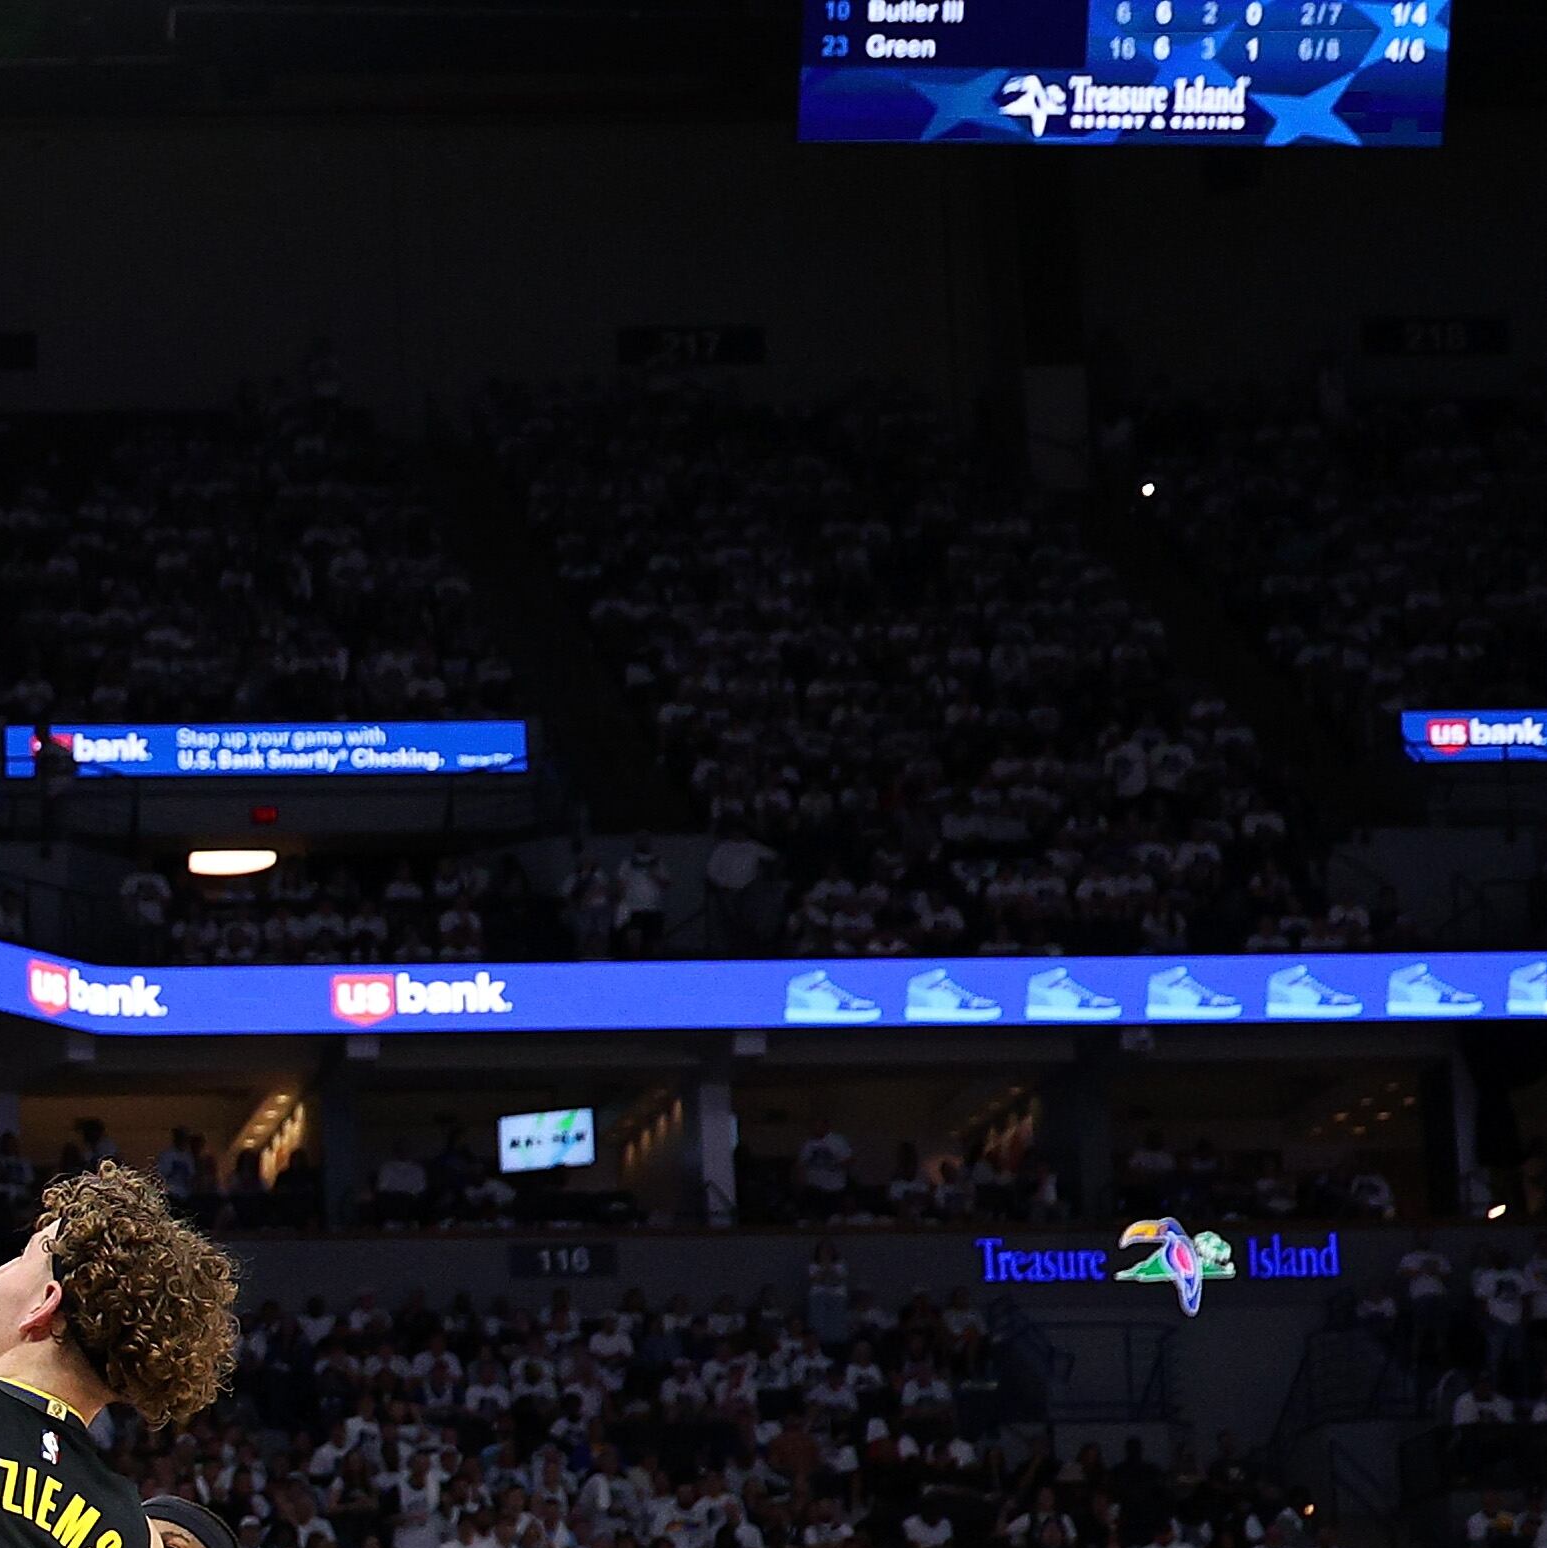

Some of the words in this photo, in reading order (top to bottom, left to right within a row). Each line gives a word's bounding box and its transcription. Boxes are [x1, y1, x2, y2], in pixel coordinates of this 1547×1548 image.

[865, 34, 937, 58] Green
[1068, 74, 1169, 114] Treasure
[1173, 74, 1248, 114] Island
[1430, 722, 1468, 744] us
[30, 968, 68, 1004] us
[335, 981, 391, 1015] us
[976, 1237, 1105, 1283] Treasure
[1248, 1232, 1341, 1279] Island
